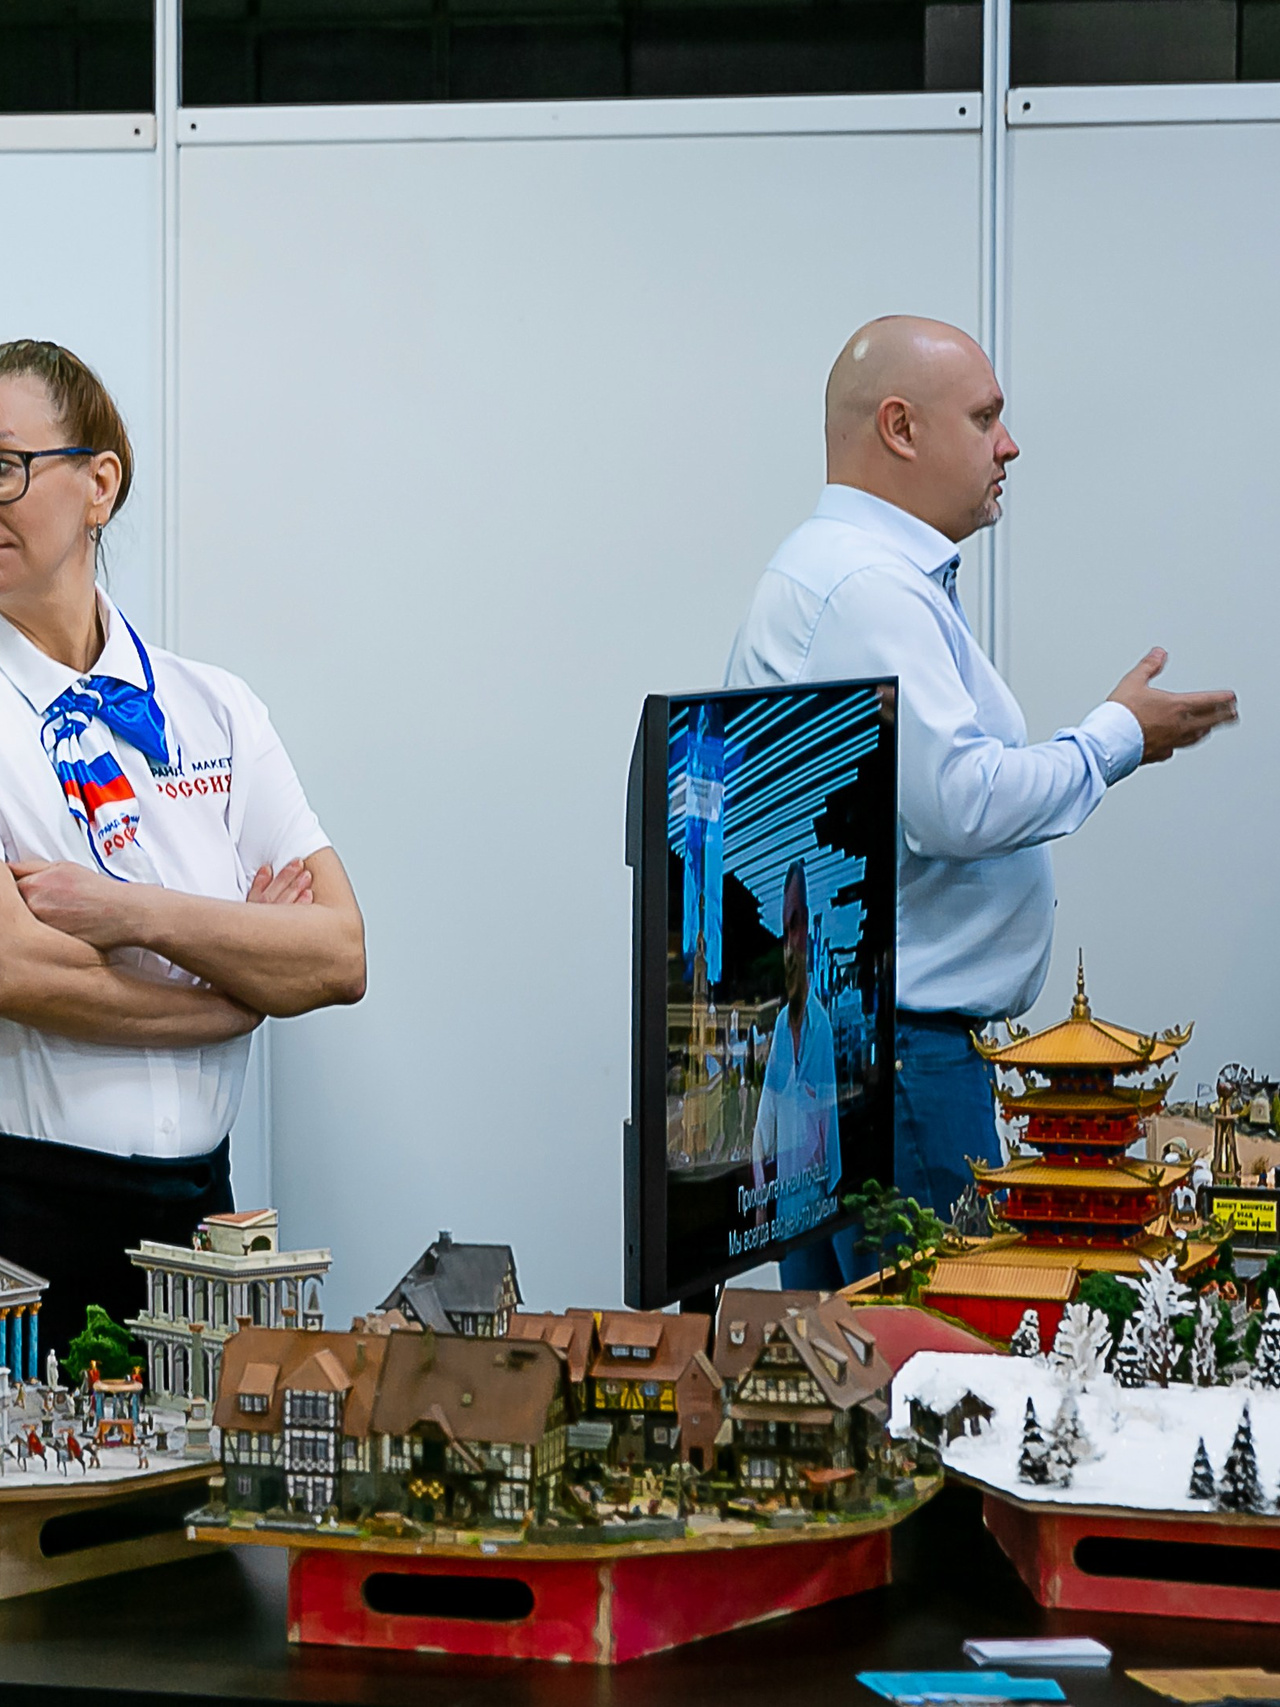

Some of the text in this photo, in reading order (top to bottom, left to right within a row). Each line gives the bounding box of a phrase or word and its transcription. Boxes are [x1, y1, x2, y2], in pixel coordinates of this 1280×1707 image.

[151, 756, 232, 778] РАНД МАКЕТ
[728, 1229, 742, 1256] Мы
